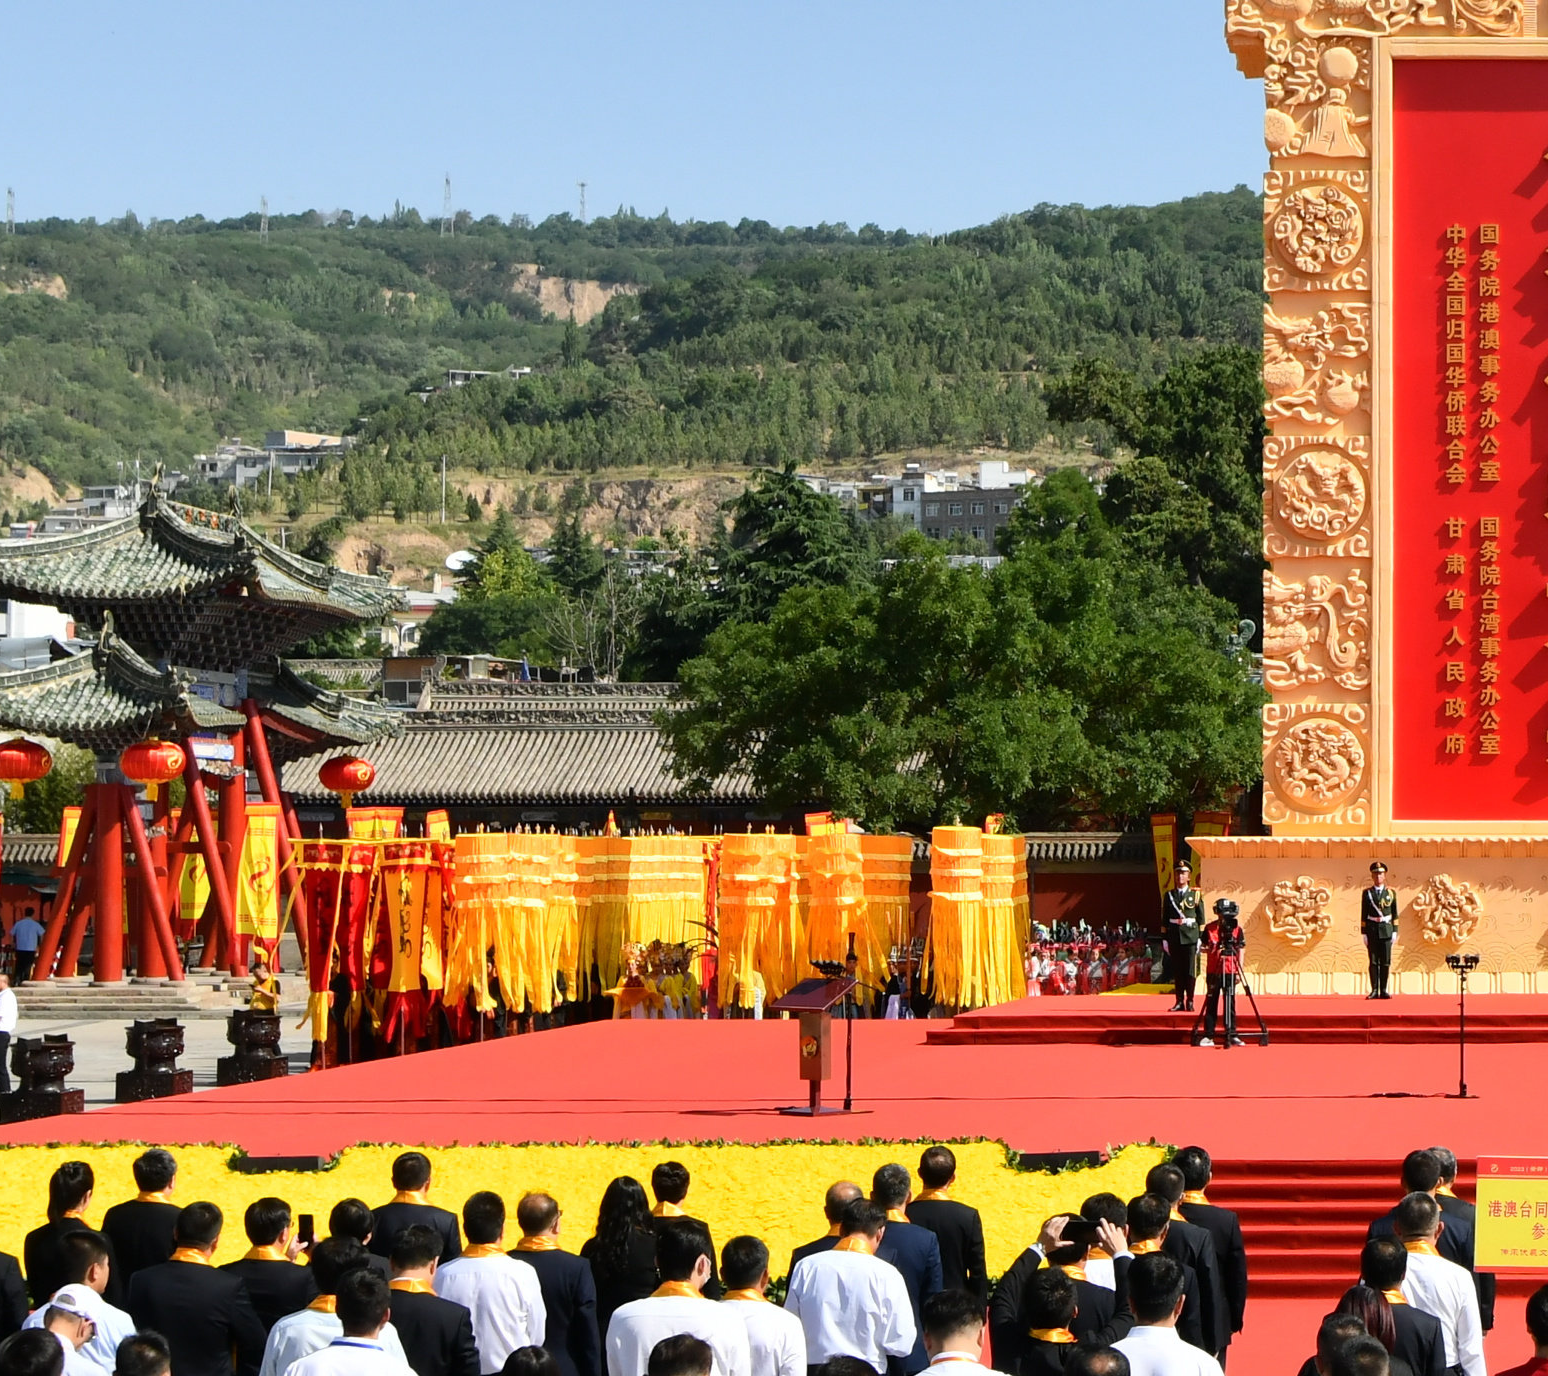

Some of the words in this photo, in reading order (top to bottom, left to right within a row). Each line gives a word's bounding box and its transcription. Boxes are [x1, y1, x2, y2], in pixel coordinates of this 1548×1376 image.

[1445, 223, 1467, 484] 中华全国归国华侨联合会
[1478, 223, 1501, 483] 国务院港澳事务办公室
[1445, 516, 1467, 755] 甘肃省人民政府
[1478, 516, 1501, 756] 国务院台湾事务办公室
